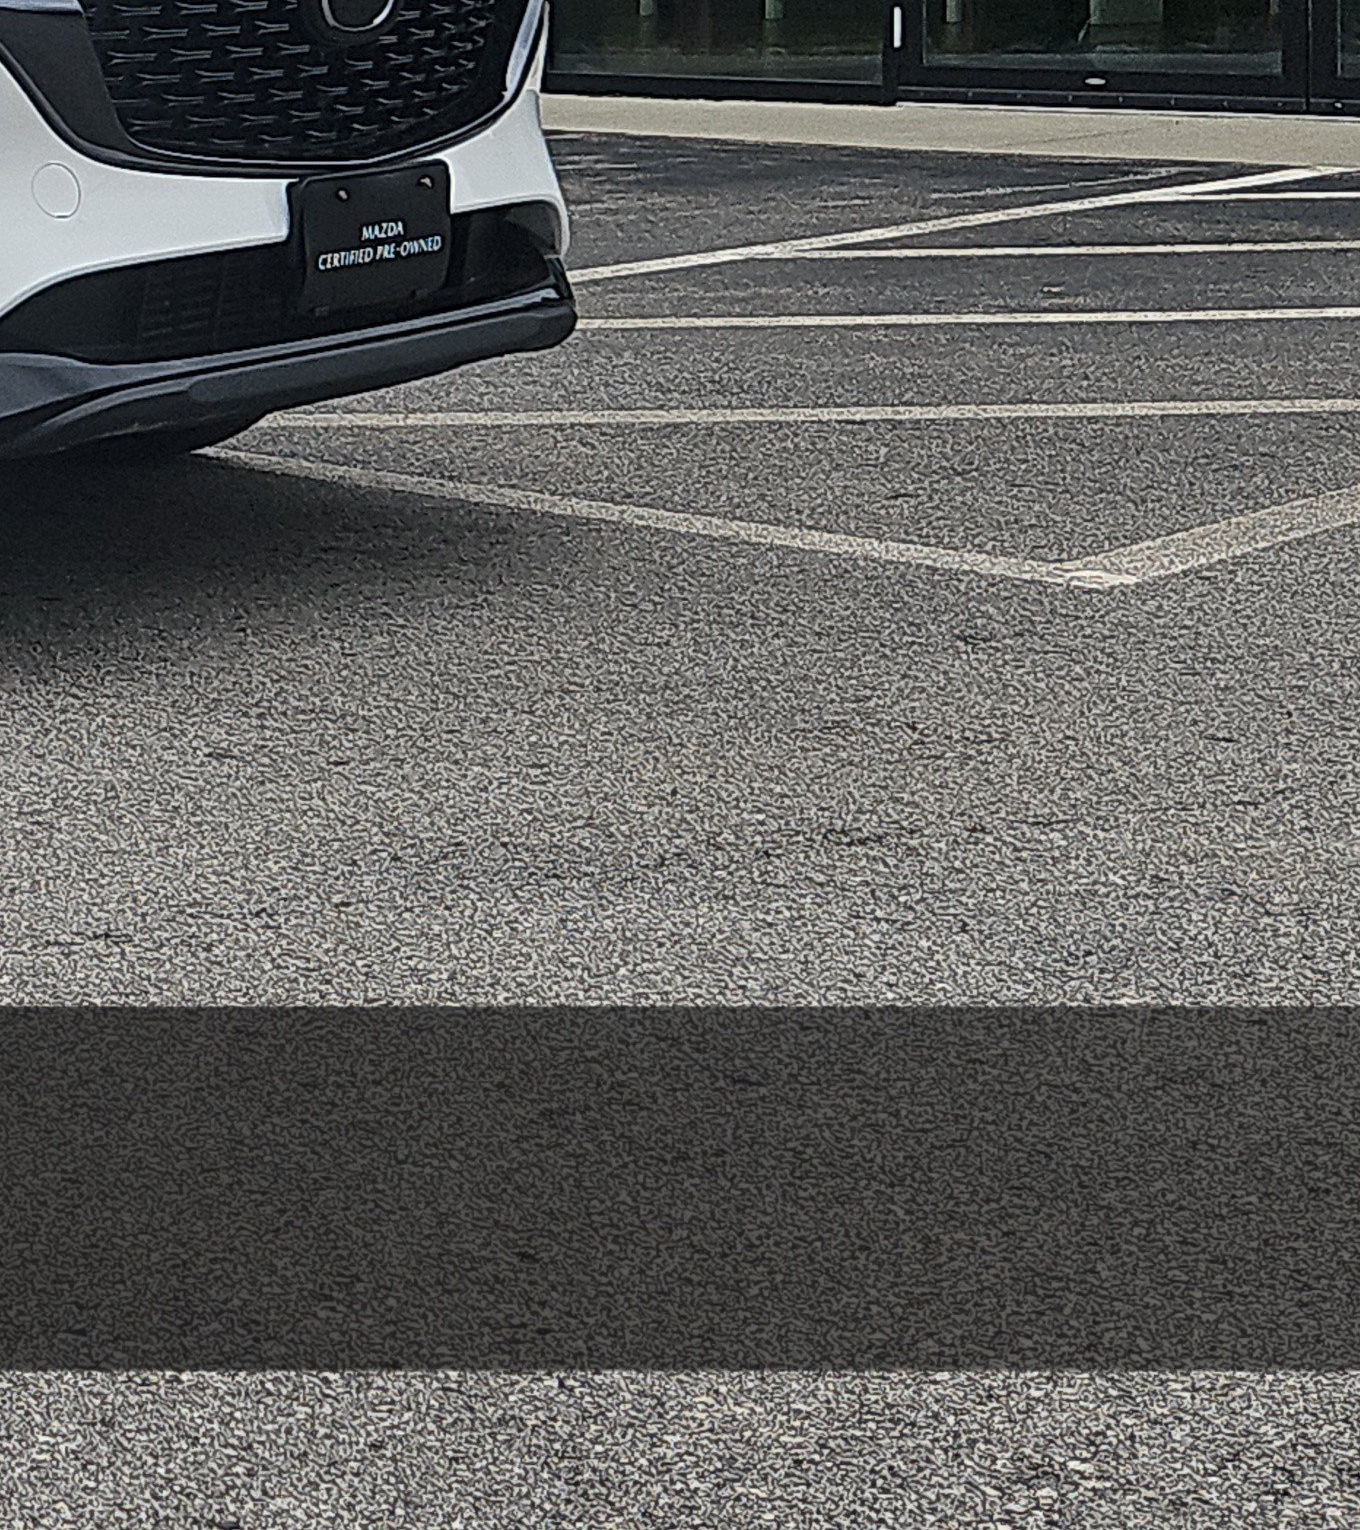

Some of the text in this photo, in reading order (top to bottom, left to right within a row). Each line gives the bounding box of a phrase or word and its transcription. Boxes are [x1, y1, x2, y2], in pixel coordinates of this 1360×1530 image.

[361, 221, 405, 241] MAZDA
[318, 235, 443, 270] CERTIFIED PRE-OWNED
